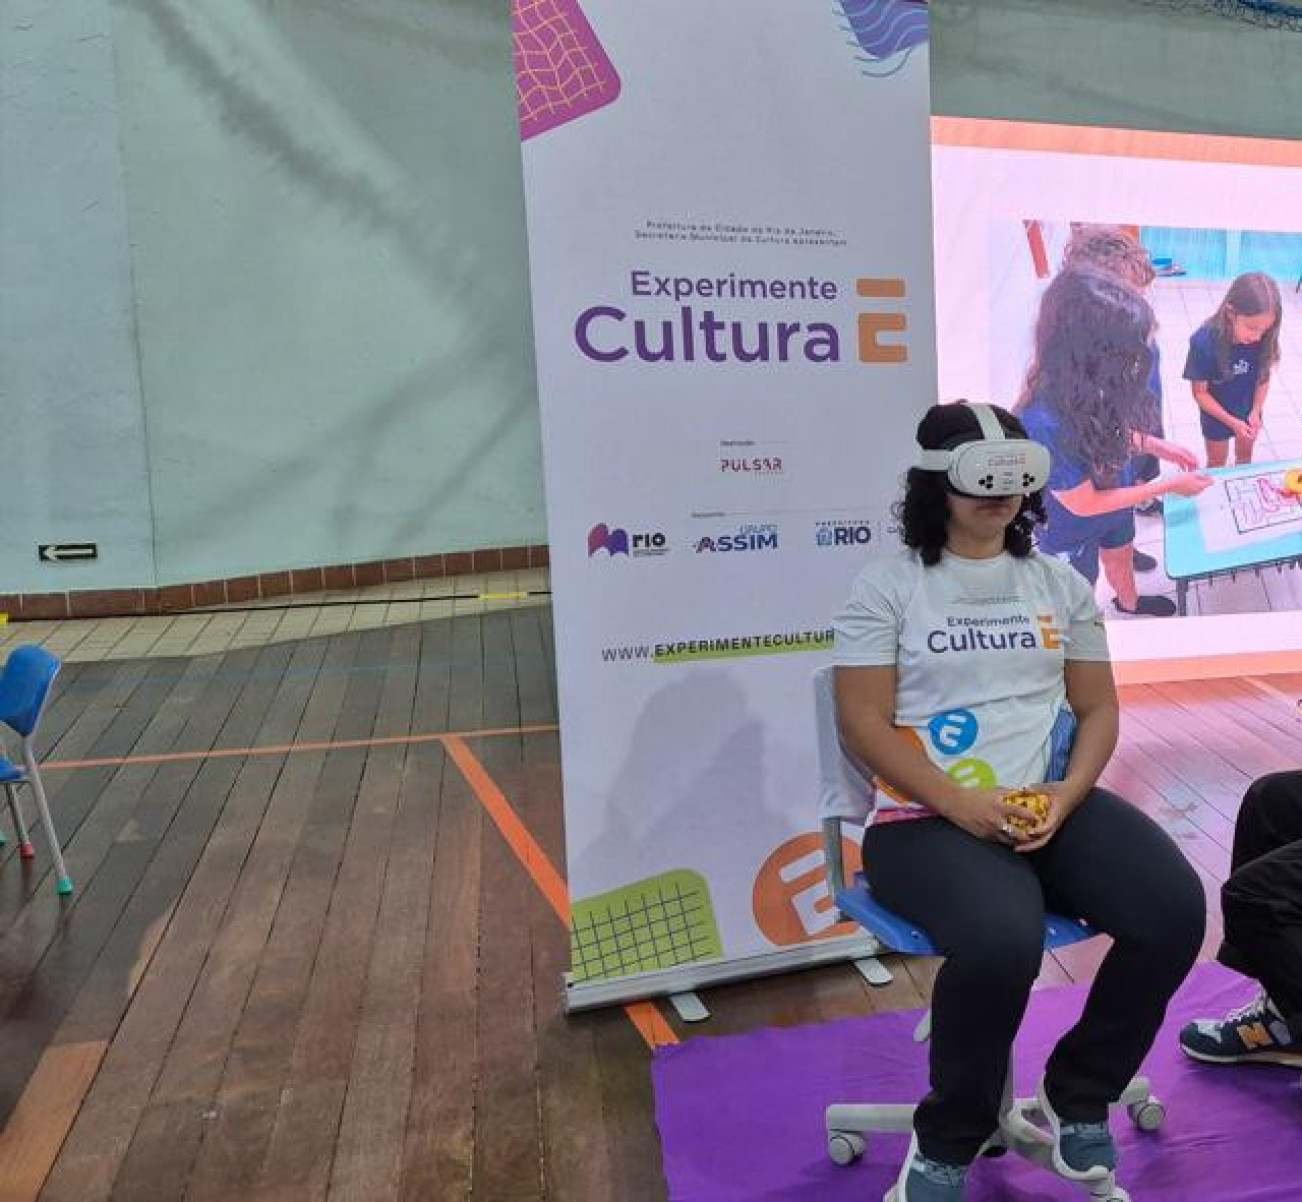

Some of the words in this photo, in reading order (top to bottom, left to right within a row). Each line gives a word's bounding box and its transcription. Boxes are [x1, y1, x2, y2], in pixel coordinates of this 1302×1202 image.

[631, 270, 838, 301] Experimente
[574, 305, 841, 363] Cultura
[720, 456, 783, 473] PULSAR
[696, 533, 778, 554] ASSIM
[834, 526, 871, 546] RIO
[947, 613, 1030, 628] Experimente
[927, 628, 1037, 654] Cultura
